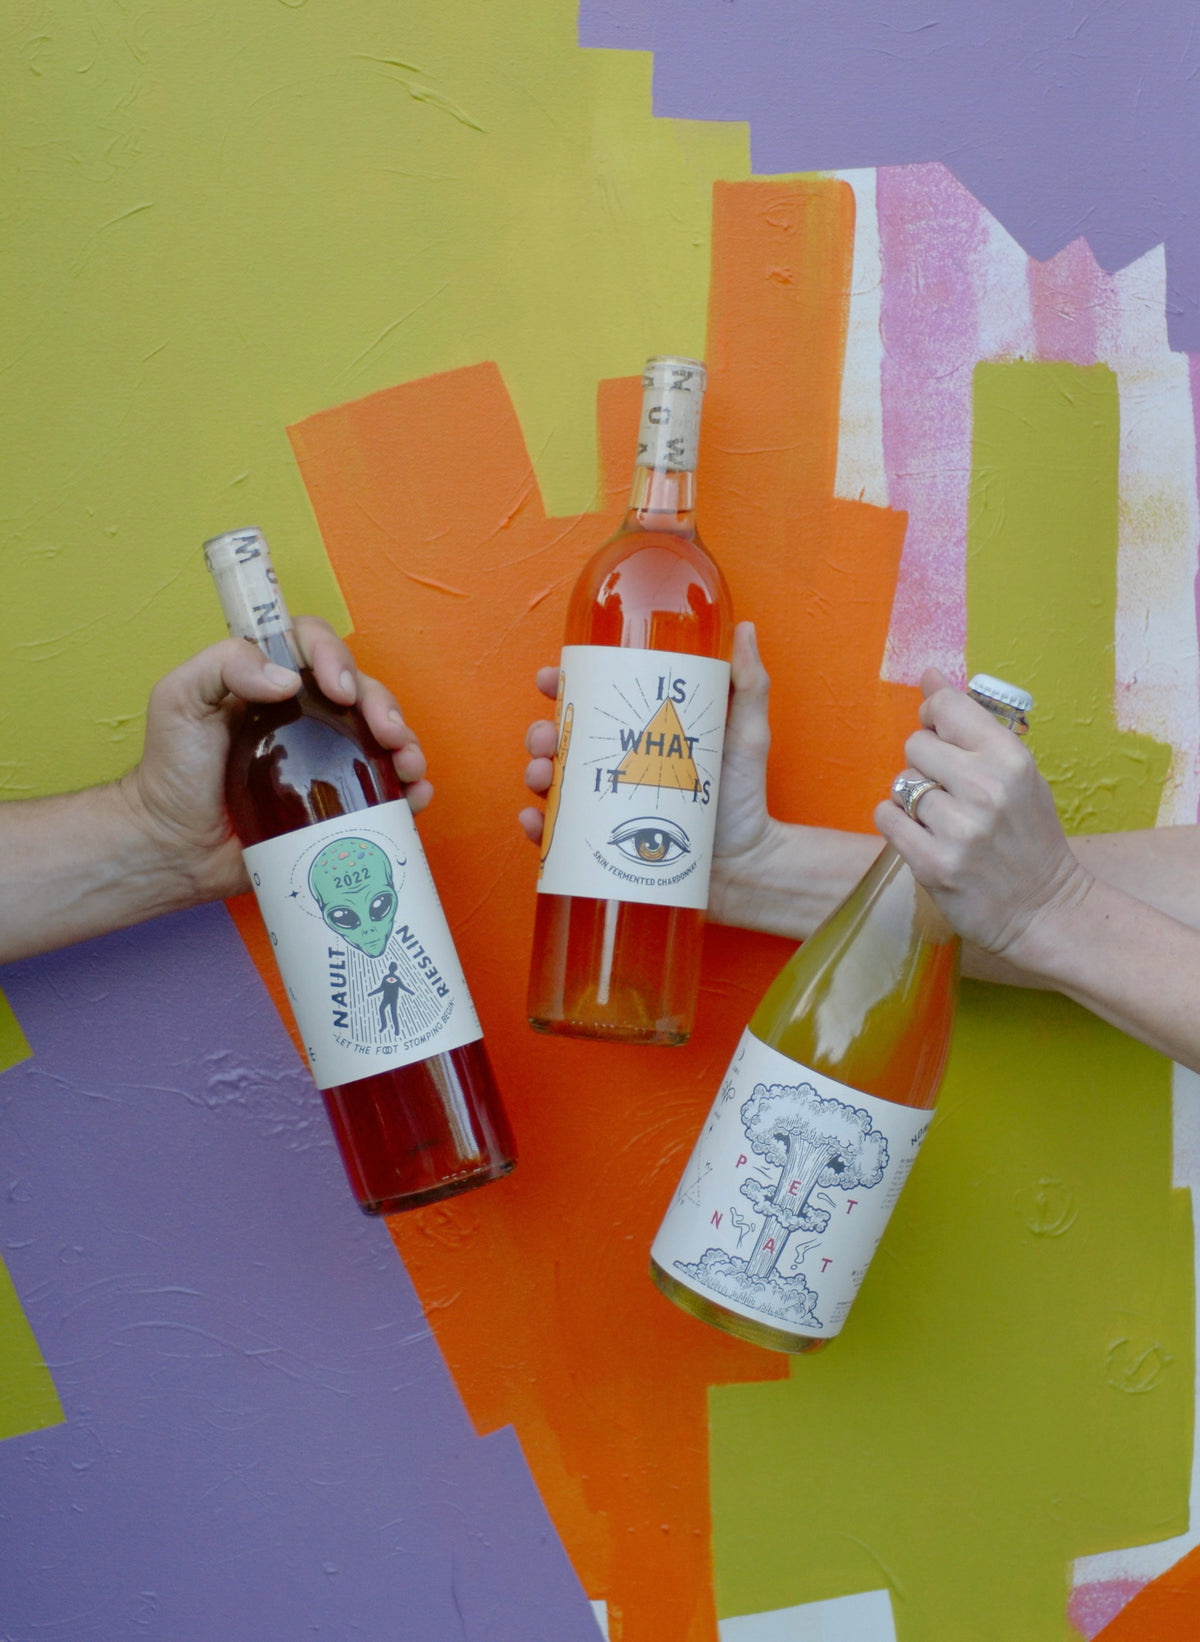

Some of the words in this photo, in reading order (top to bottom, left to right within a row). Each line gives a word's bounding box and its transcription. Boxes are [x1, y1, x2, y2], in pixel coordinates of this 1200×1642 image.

[656, 676, 687, 704] IS
[619, 728, 699, 759] WHAT
[594, 768, 626, 794] IT
[692, 778, 711, 805] IS
[334, 867, 371, 888] 2022
[592, 850, 609, 869] SKIN
[608, 865, 656, 886] FERMENTED
[657, 860, 698, 886] CHARDONNAY
[395, 925, 450, 998] RIESLIN
[328, 947, 349, 1028] NAULT
[354, 1043, 371, 1055] THE
[403, 1022, 443, 1051] STOMPING
